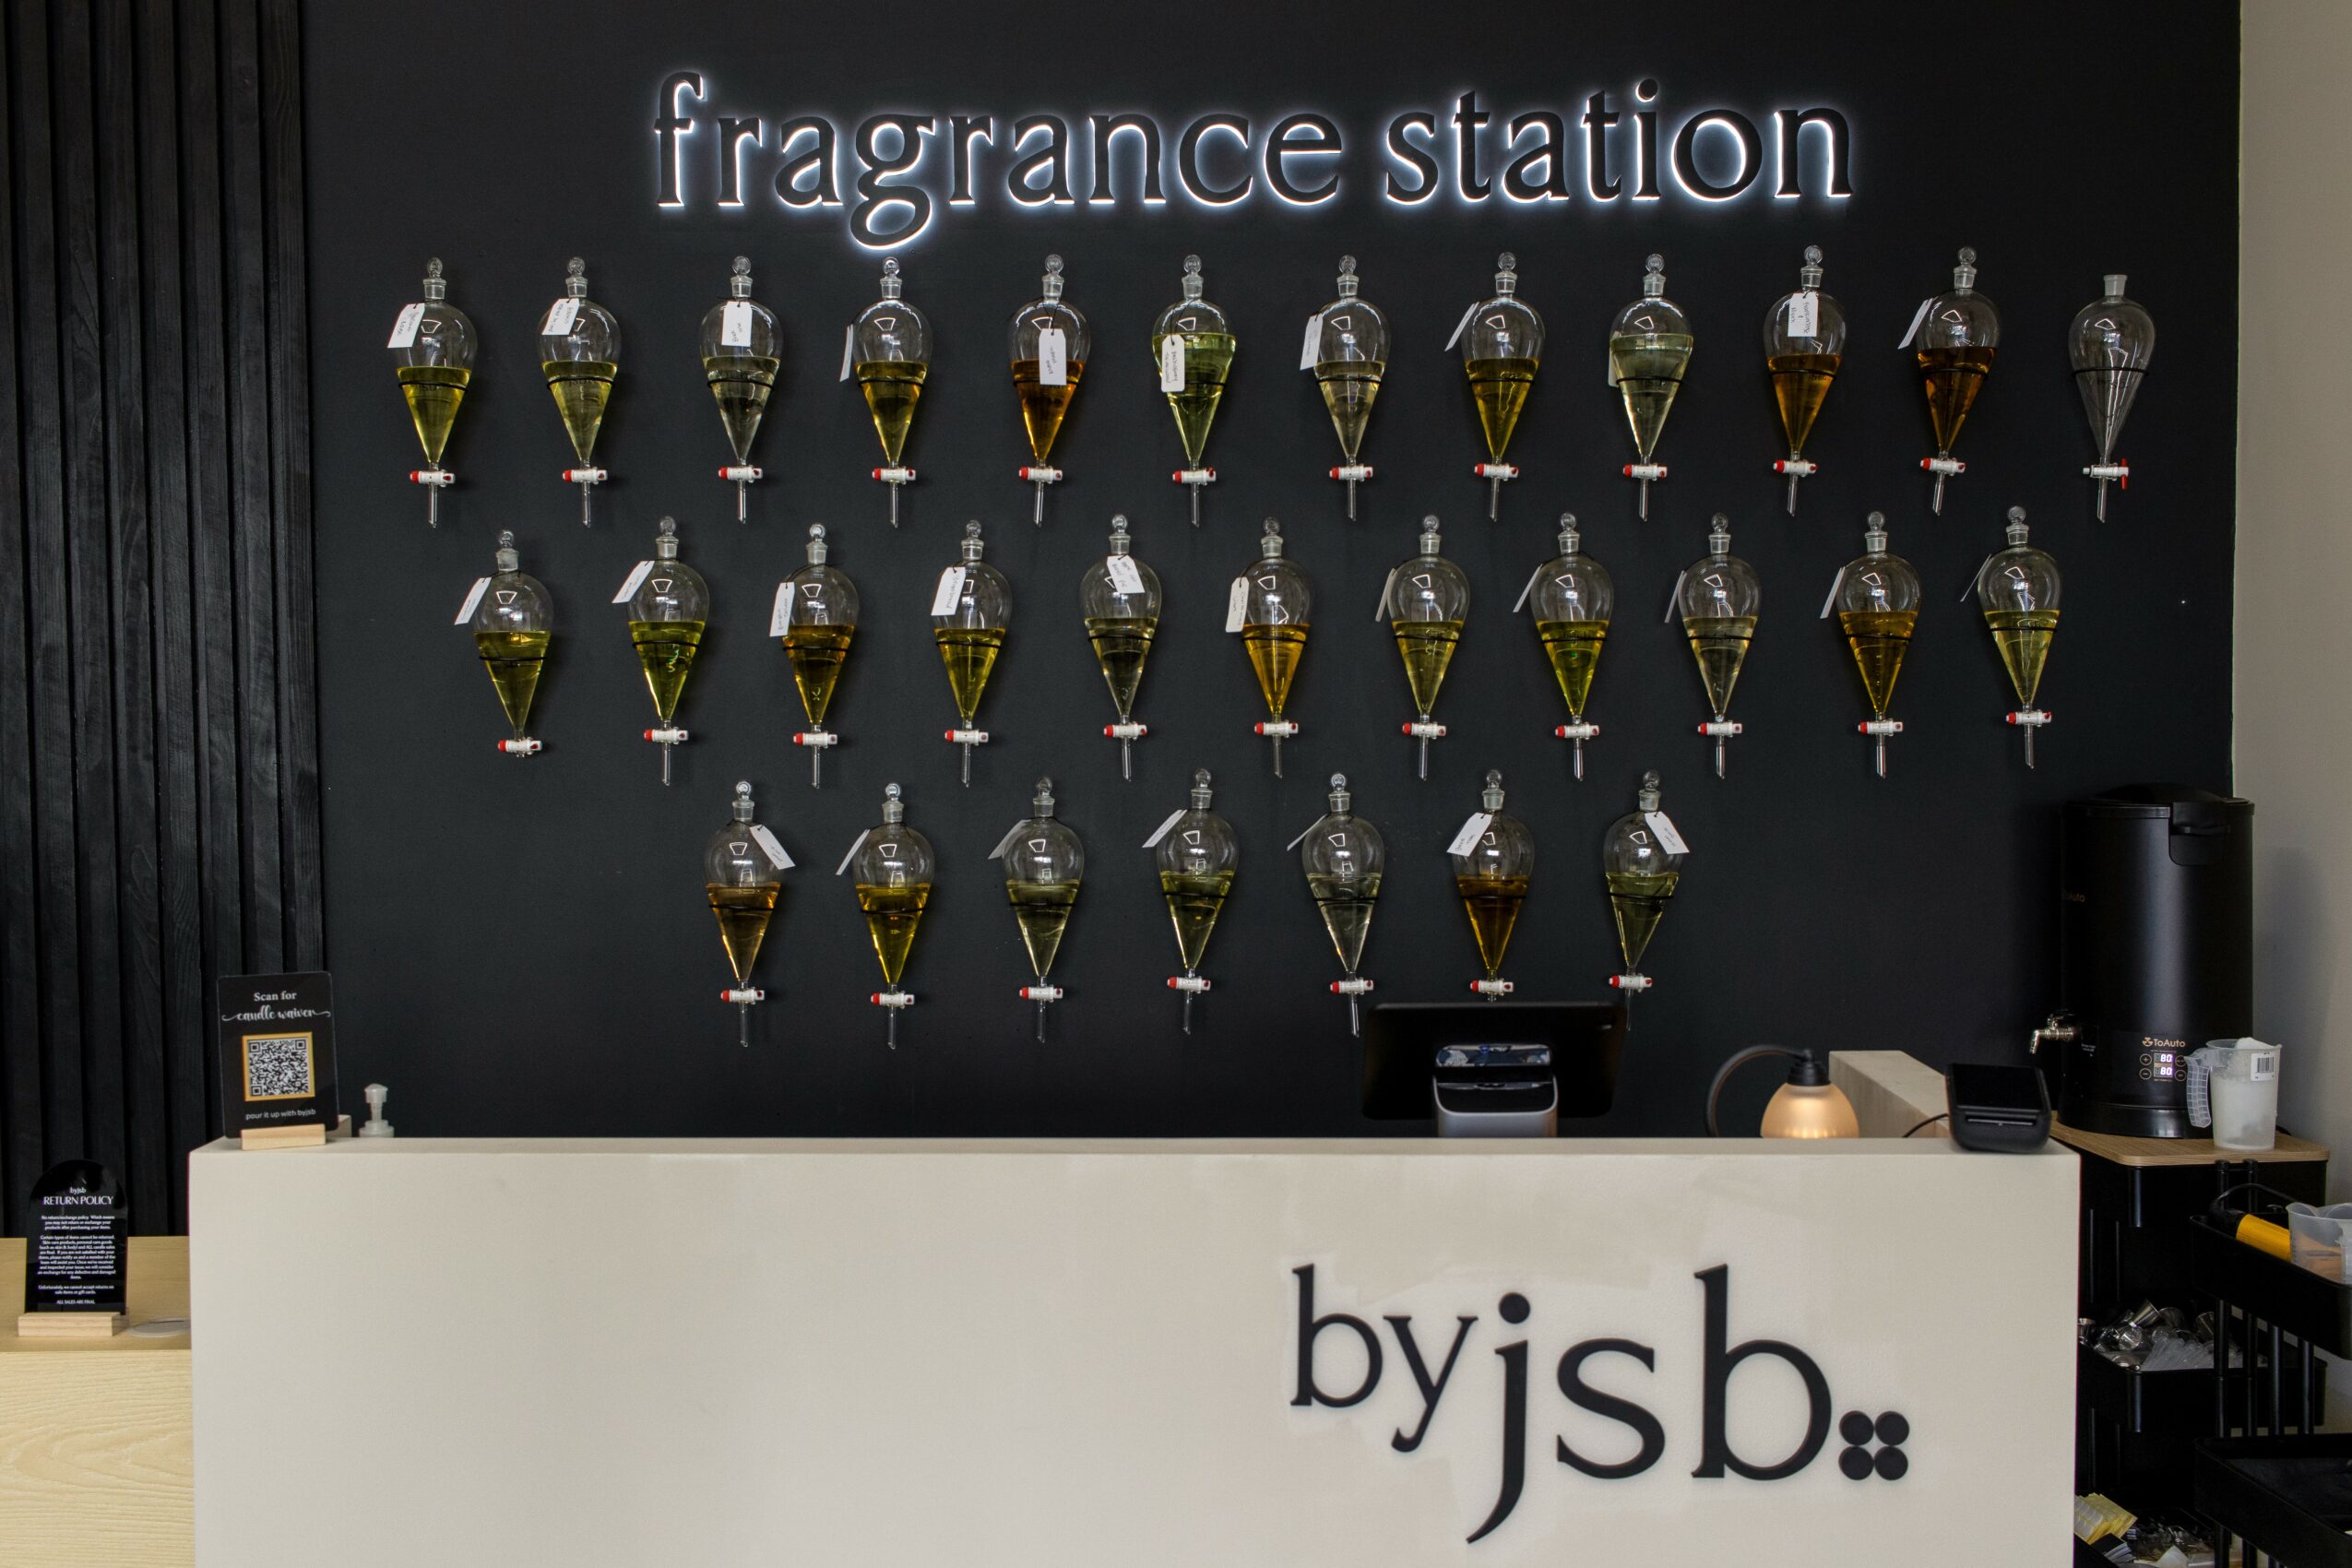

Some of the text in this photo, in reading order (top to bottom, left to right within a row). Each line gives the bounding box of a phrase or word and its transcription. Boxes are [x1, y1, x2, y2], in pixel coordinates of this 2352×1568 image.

[653, 71, 1855, 250] fragrance station
[254, 991, 297, 1002] Scan for
[222, 1004, 331, 1021] candle waiver
[2153, 1039, 2186, 1047] ToAuto
[2160, 1054, 2172, 1063] 80
[2160, 1067, 2172, 1075] 80
[245, 1112, 263, 1121] pour
[69, 1186, 87, 1194] byjsb
[43, 1195, 113, 1205] RETURN POLICY
[1290, 1263, 1833, 1545] byjsb
